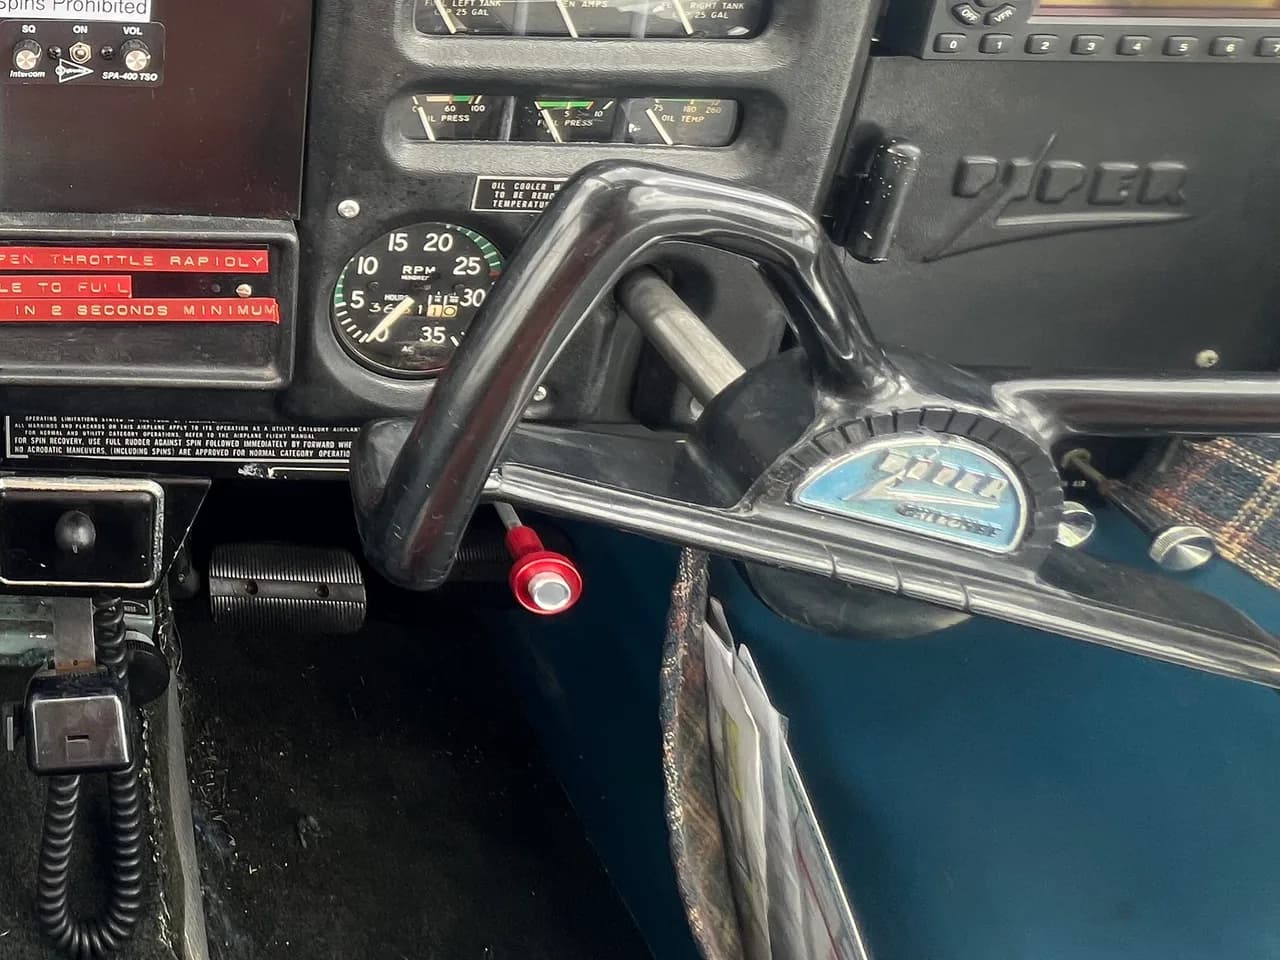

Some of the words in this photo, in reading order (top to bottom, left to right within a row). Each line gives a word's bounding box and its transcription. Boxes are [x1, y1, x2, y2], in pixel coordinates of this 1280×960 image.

[453, 0, 475, 7] LEFT
[22, 25, 36, 33] SQ
[123, 26, 142, 35] VOL
[10, 70, 45, 78] Intercom
[102, 72, 137, 80] SPA-400
[140, 73, 158, 81] TSO
[388, 233, 408, 252] 15
[423, 233, 453, 252] 20
[52, 254, 155, 267] THROTTLE
[169, 255, 264, 268] RAPIDLY
[357, 256, 378, 275] 10
[452, 257, 481, 276] 25
[402, 265, 436, 275] RPM
[38, 282, 63, 294] TO
[15, 305, 35, 316] IN
[51, 305, 63, 316] 2
[78, 305, 168, 317] SECONDS
[183, 304, 276, 317] MINIMUM
[419, 327, 446, 344] 35
[244, 440, 287, 448] IMMEDIATELY
[195, 448, 229, 456] APPROVED
